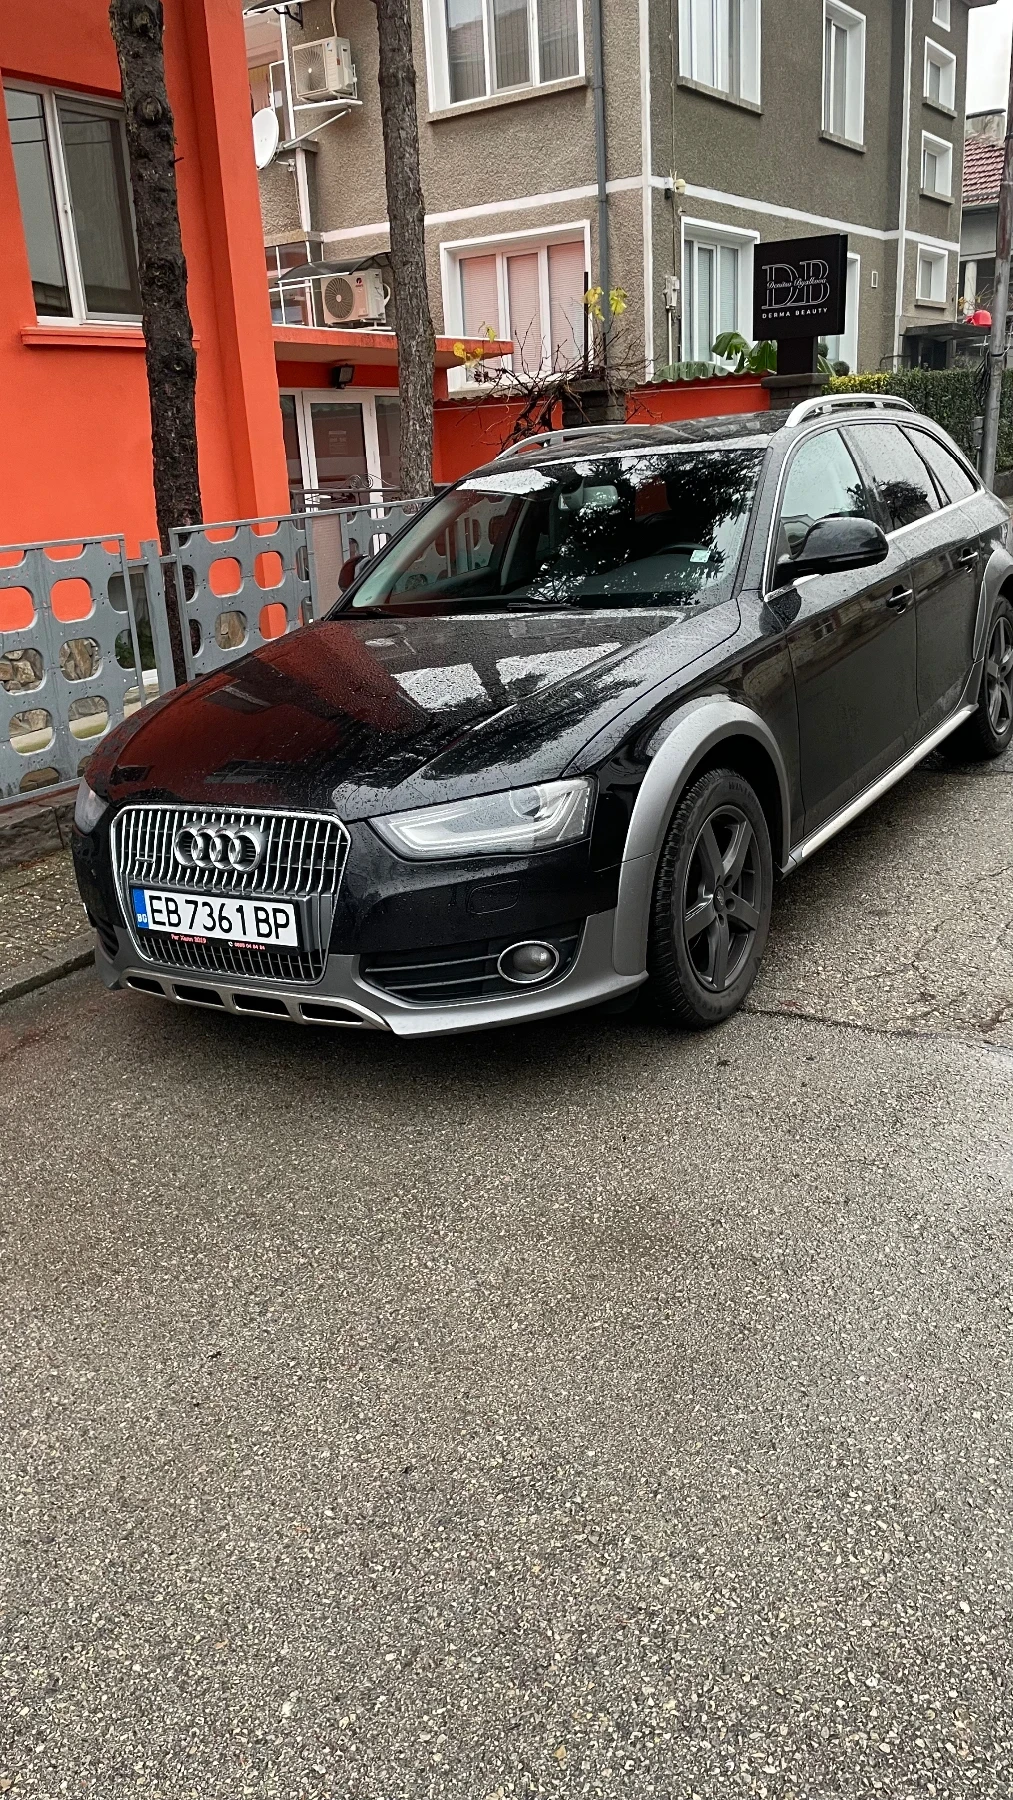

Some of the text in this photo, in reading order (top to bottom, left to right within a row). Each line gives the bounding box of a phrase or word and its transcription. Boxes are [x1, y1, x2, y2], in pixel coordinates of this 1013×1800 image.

[762, 307, 828, 319] DERMA BEAUTY
[137, 913, 148, 923] BG
